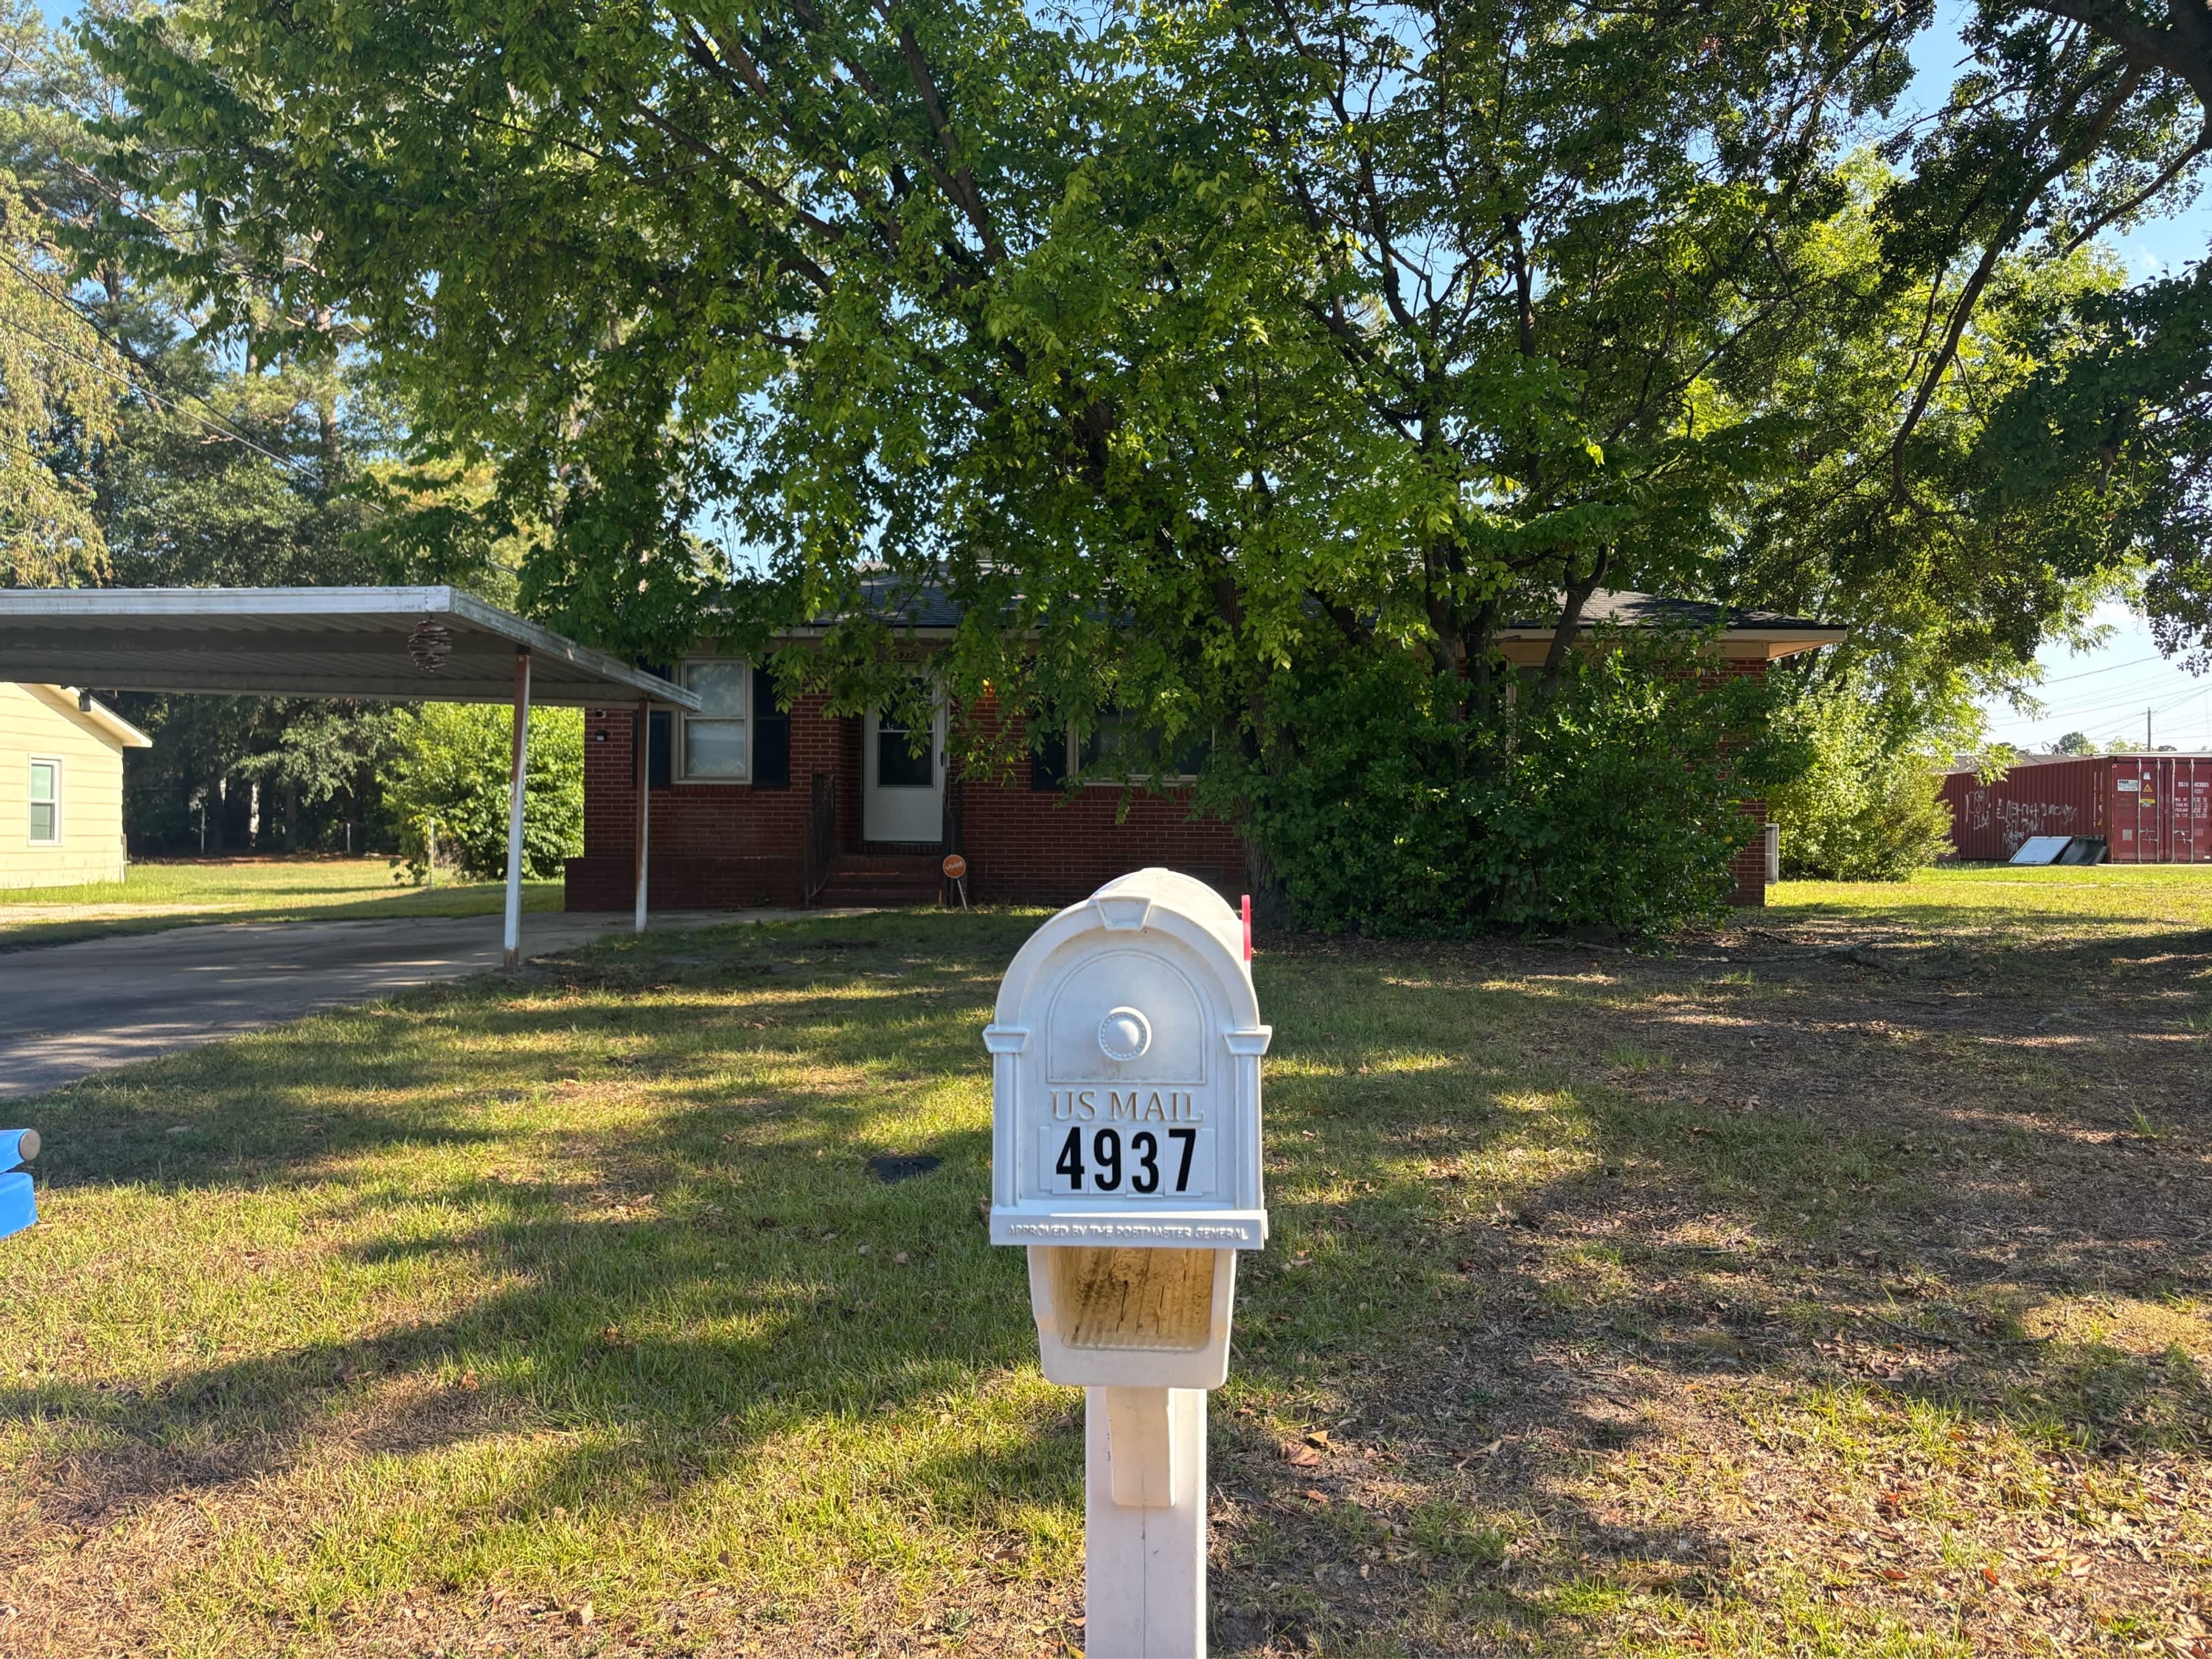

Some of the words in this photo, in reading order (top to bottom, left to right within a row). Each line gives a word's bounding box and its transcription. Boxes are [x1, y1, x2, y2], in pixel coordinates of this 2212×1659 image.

[1050, 1090, 1096, 1121] US
[1109, 1090, 1204, 1122] MAIL
[1056, 1126, 1197, 1194] 4937
[1008, 1223, 1070, 1237] APPROVED
[1072, 1224, 1088, 1236] BY
[1089, 1224, 1114, 1237] THE
[1116, 1225, 1192, 1239] POSTMASTER
[1195, 1226, 1248, 1240] GENERAL
